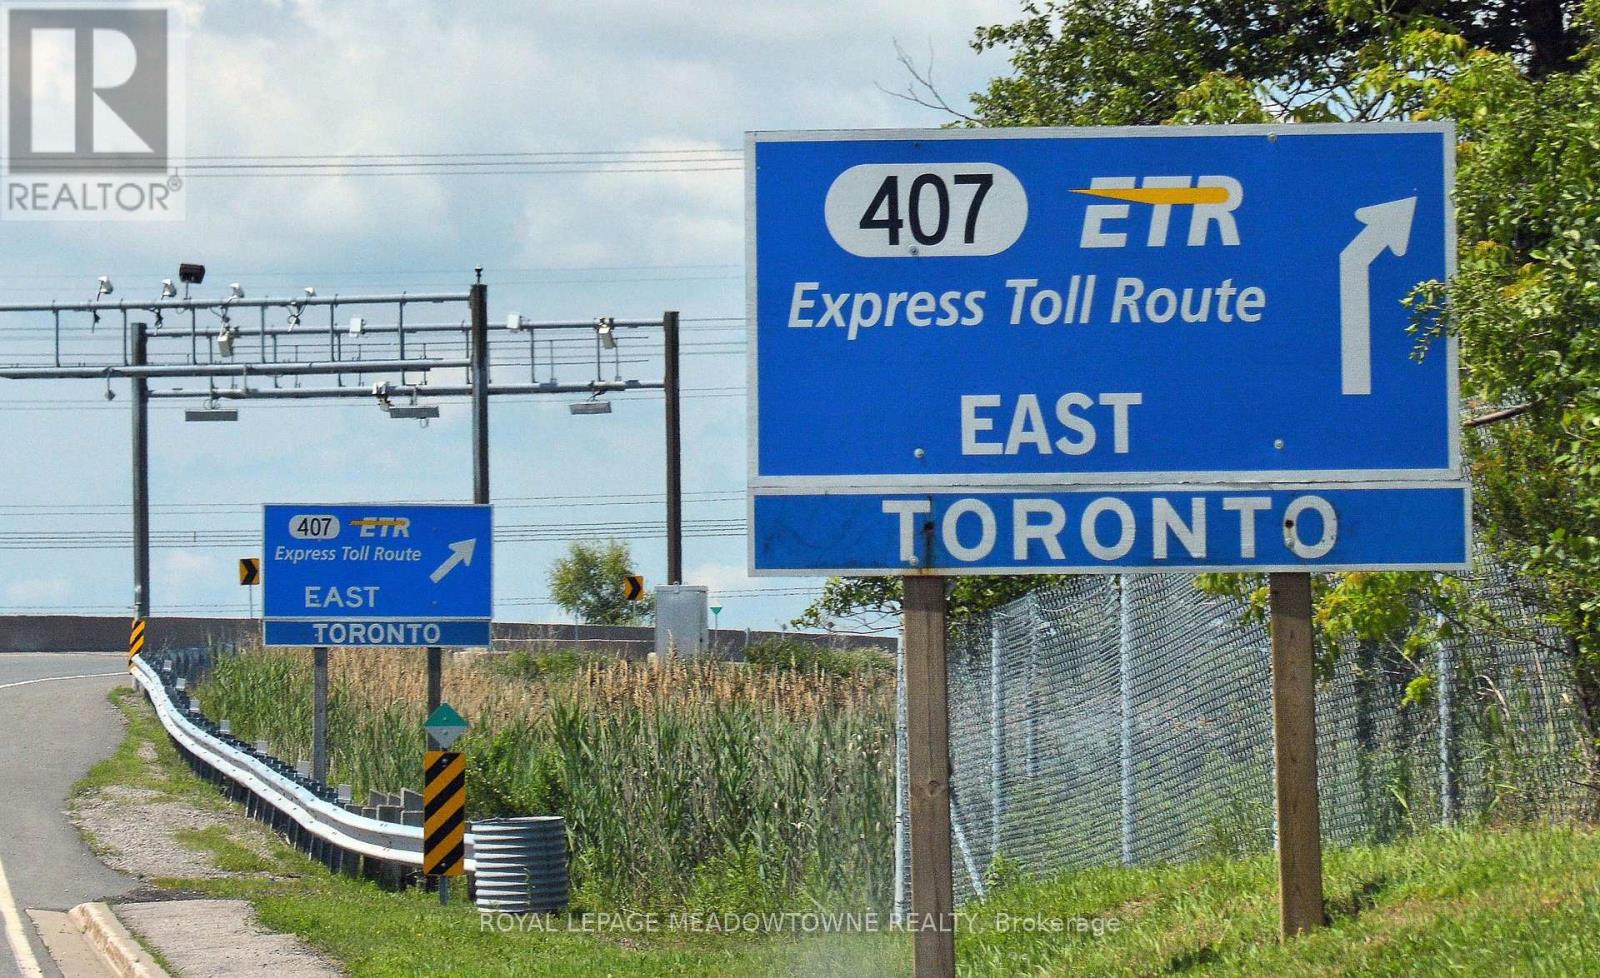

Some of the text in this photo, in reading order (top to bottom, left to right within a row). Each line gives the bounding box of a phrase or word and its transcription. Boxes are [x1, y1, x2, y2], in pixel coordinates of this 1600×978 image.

[859, 173, 994, 246] 407
[1079, 175, 1243, 248] ETR
[788, 275, 1266, 341] Express Toll Route
[961, 392, 1142, 455] EAST
[297, 518, 332, 536] 407
[360, 517, 411, 538] ETR
[882, 496, 1338, 562] TORONTO
[275, 545, 422, 564] Express Toll Route
[304, 586, 380, 608] EAST
[313, 623, 441, 644] TORONTO
